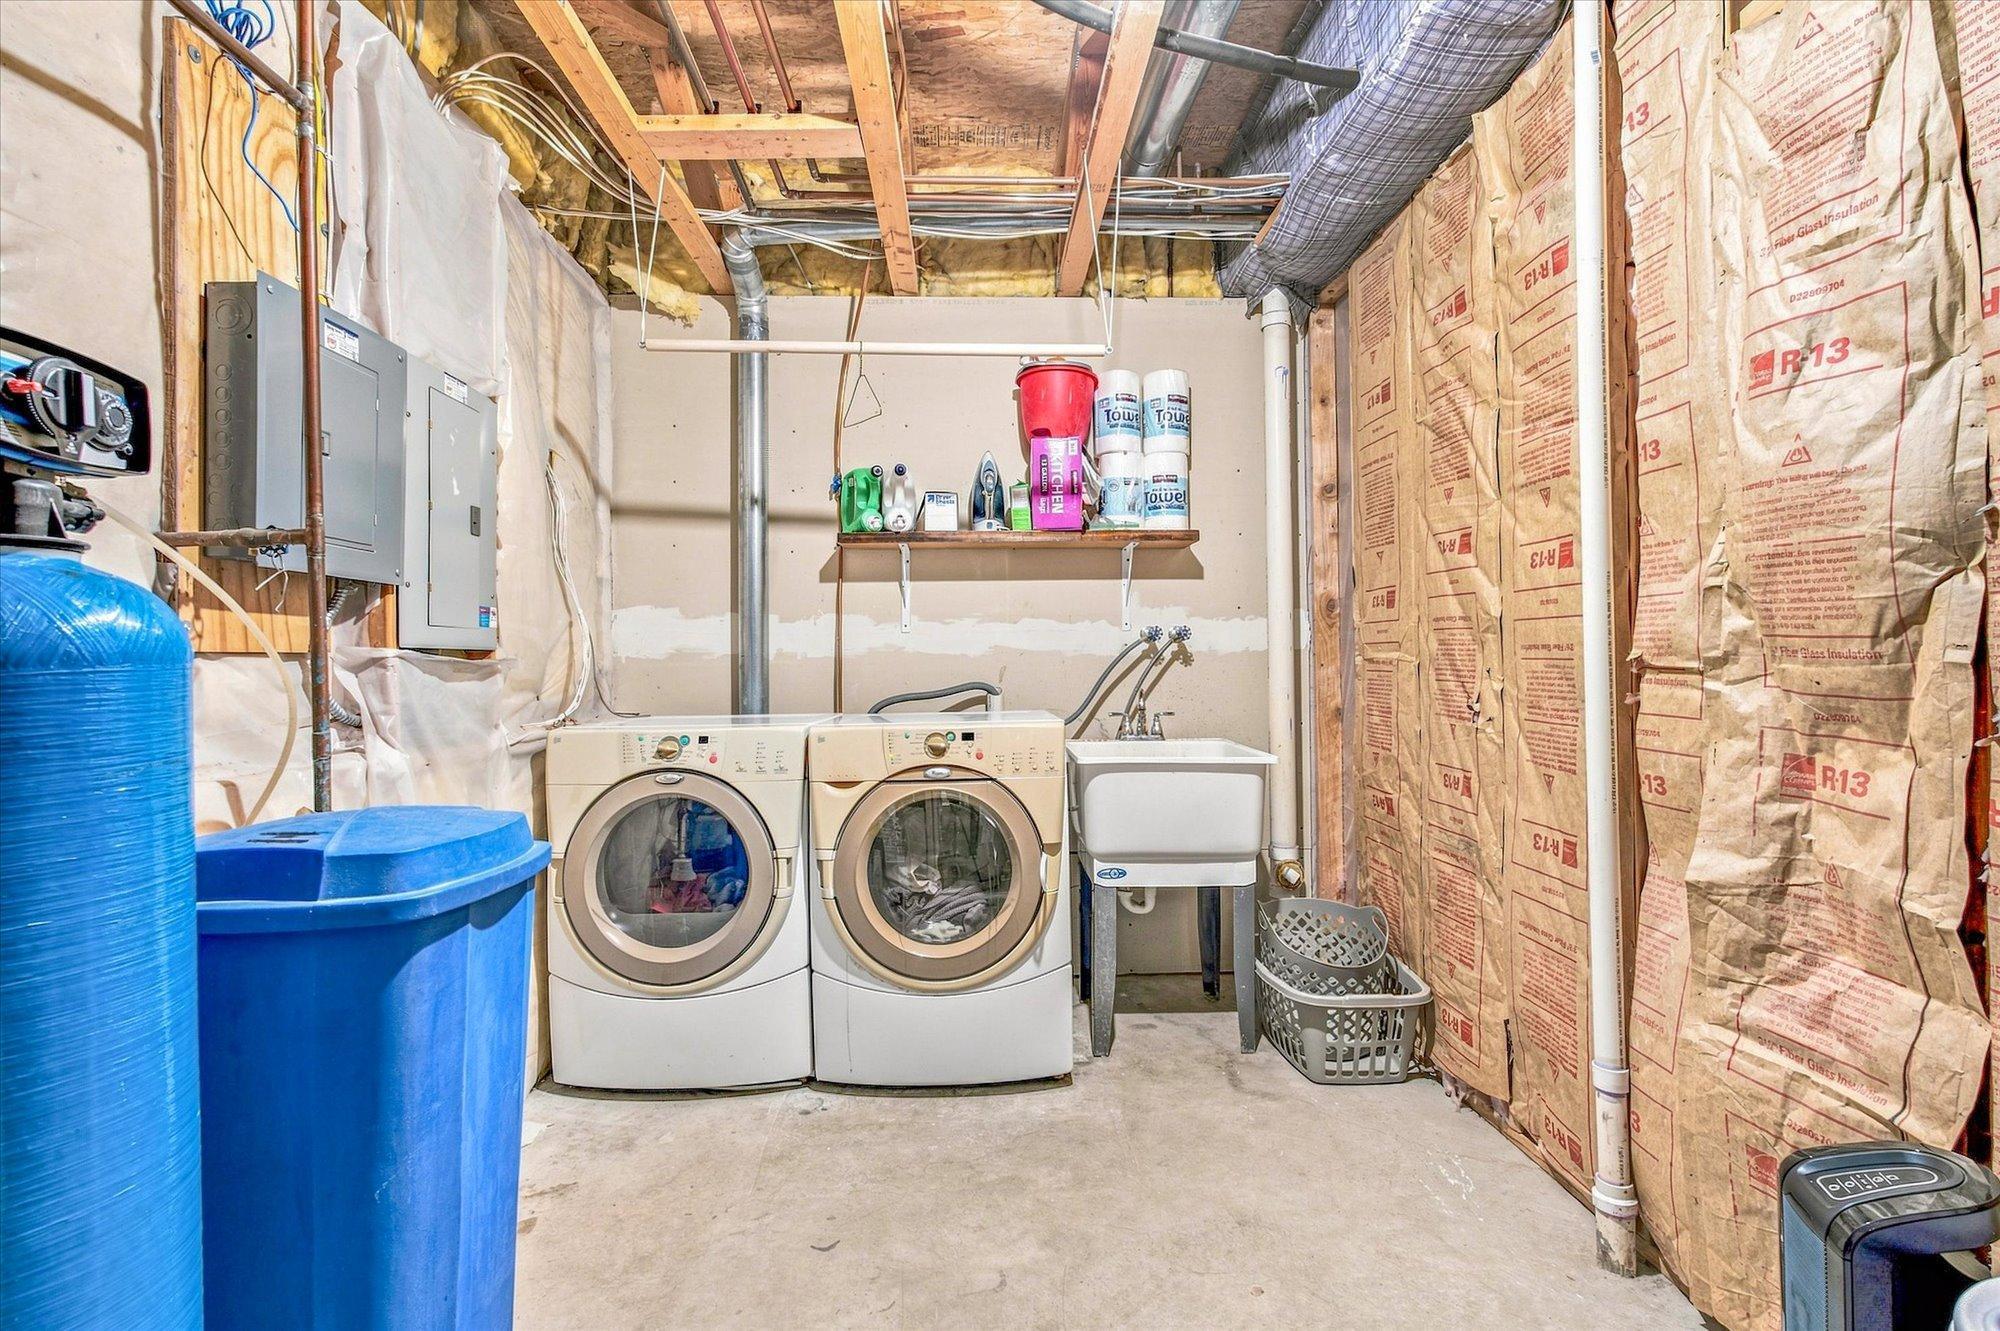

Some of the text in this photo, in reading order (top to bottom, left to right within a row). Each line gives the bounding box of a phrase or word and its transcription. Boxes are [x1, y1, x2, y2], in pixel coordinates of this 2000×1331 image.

[1796, 219, 1823, 239] Glass
[1823, 193, 1879, 226] Insulation
[1523, 259, 1549, 291] R-13
[1780, 336, 1851, 376] R-13
[1639, 439, 1661, 463] -13
[1050, 439, 1064, 514] KITCHEN
[1742, 478, 1774, 492] arning:
[1530, 548, 1556, 570] R-13
[1800, 647, 1825, 660] Glass
[1827, 648, 1882, 660] Insulation
[1443, 773, 1460, 791] R-13
[1641, 774, 1667, 796] -13
[1822, 765, 1871, 799] R-13
[1533, 832, 1560, 858] R-13
[1442, 1008, 1459, 1034] R-13
[1779, 1046, 1804, 1066] Fiber
[1808, 1057, 1836, 1081] Glass
[1837, 1071, 1889, 1107] Insulation
[1544, 1114, 1567, 1151] R-13
